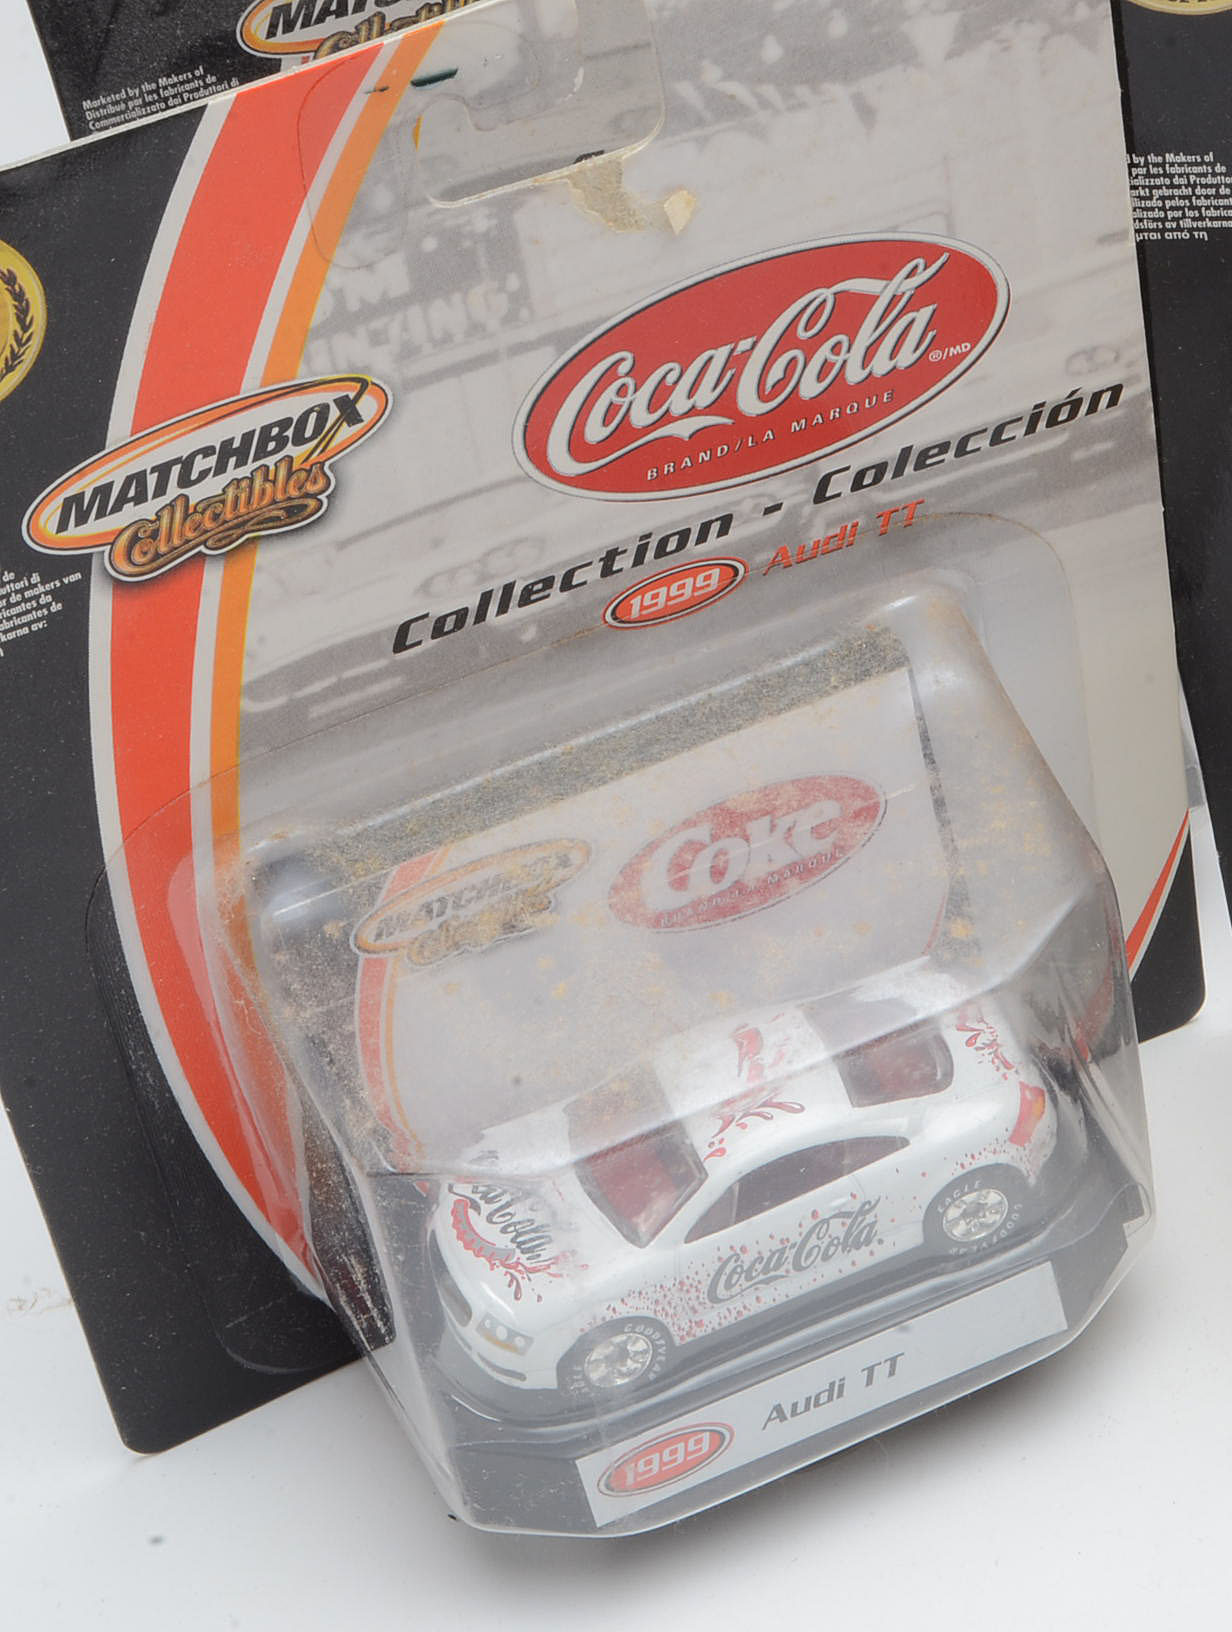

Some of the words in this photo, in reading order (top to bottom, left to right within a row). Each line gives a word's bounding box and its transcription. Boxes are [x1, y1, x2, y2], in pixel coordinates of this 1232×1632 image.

[82, 89, 127, 111] Marketed
[127, 86, 140, 98] by
[141, 81, 157, 92] the
[157, 72, 193, 87] Makers
[194, 65, 204, 77] of
[127, 99, 143, 111] par
[144, 92, 158, 104] les
[159, 79, 204, 98] fabricants
[205, 74, 217, 85] de
[167, 97, 182, 108] dai
[183, 84, 230, 103] Produttori
[1131, 166, 1147, 177] par
[1148, 164, 1164, 174] les
[1165, 163, 1213, 174] fabricants
[1214, 162, 1227, 173] de
[1132, 153, 1145, 166] by
[1147, 152, 1163, 164] the
[1165, 151, 1202, 163] Makers
[1203, 151, 1214, 162] of
[1152, 185, 1193, 199] gebracht
[1194, 184, 1216, 196] door
[1218, 184, 1231, 195] de
[1172, 174, 1188, 185] dai
[1164, 196, 1190, 209] pelos
[1166, 209, 1183, 221] por
[1184, 206, 1200, 218] los
[1164, 220, 1177, 230] av
[546, 252, 951, 476] Coca-Cola
[645, 427, 777, 482] BRAND/LA
[790, 388, 896, 434] MARQUE
[54, 392, 366, 538] MATCHBOX
[110, 454, 332, 579] Collectibles
[392, 512, 734, 656] Collection
[811, 381, 1126, 507] Colección
[2, 570, 16, 582] de
[627, 565, 723, 621] 1999
[762, 520, 859, 575] Audi
[875, 499, 925, 536] TT
[9, 592, 22, 604] de
[24, 579, 61, 599] makers
[62, 571, 82, 585] van
[38, 593, 53, 605] da
[49, 601, 63, 613] de
[640, 798, 843, 911] Coke
[706, 1195, 882, 1306] Coca-Cola
[621, 1431, 712, 1487] 1999
[760, 1376, 848, 1432] Audi
[859, 1351, 906, 1390] TT
